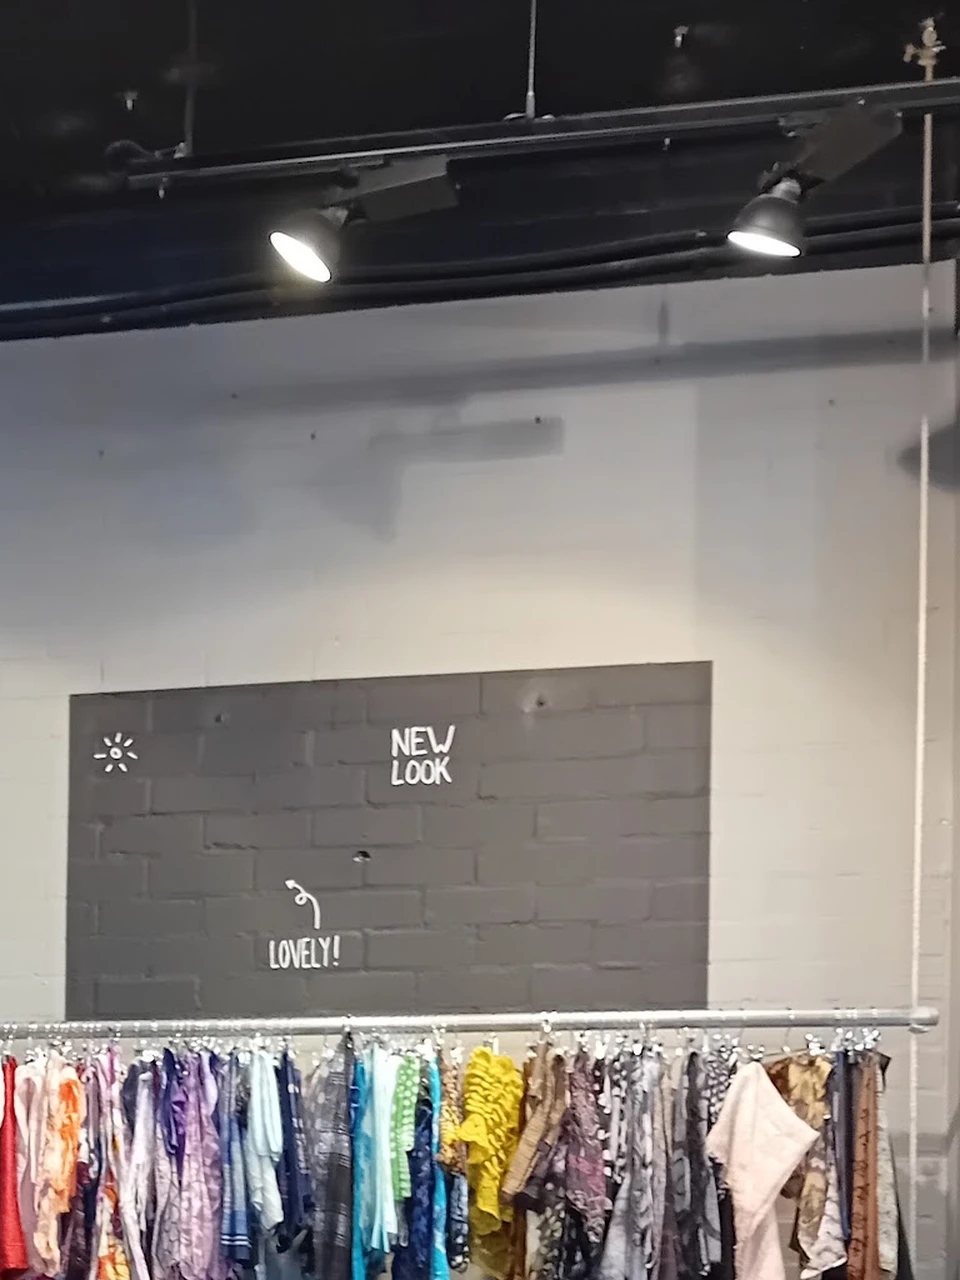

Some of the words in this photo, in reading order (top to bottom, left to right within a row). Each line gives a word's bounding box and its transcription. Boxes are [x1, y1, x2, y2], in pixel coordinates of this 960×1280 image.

[391, 725, 456, 757] NEW
[391, 756, 452, 786] LOOK
[268, 935, 340, 969] LOVELY!
